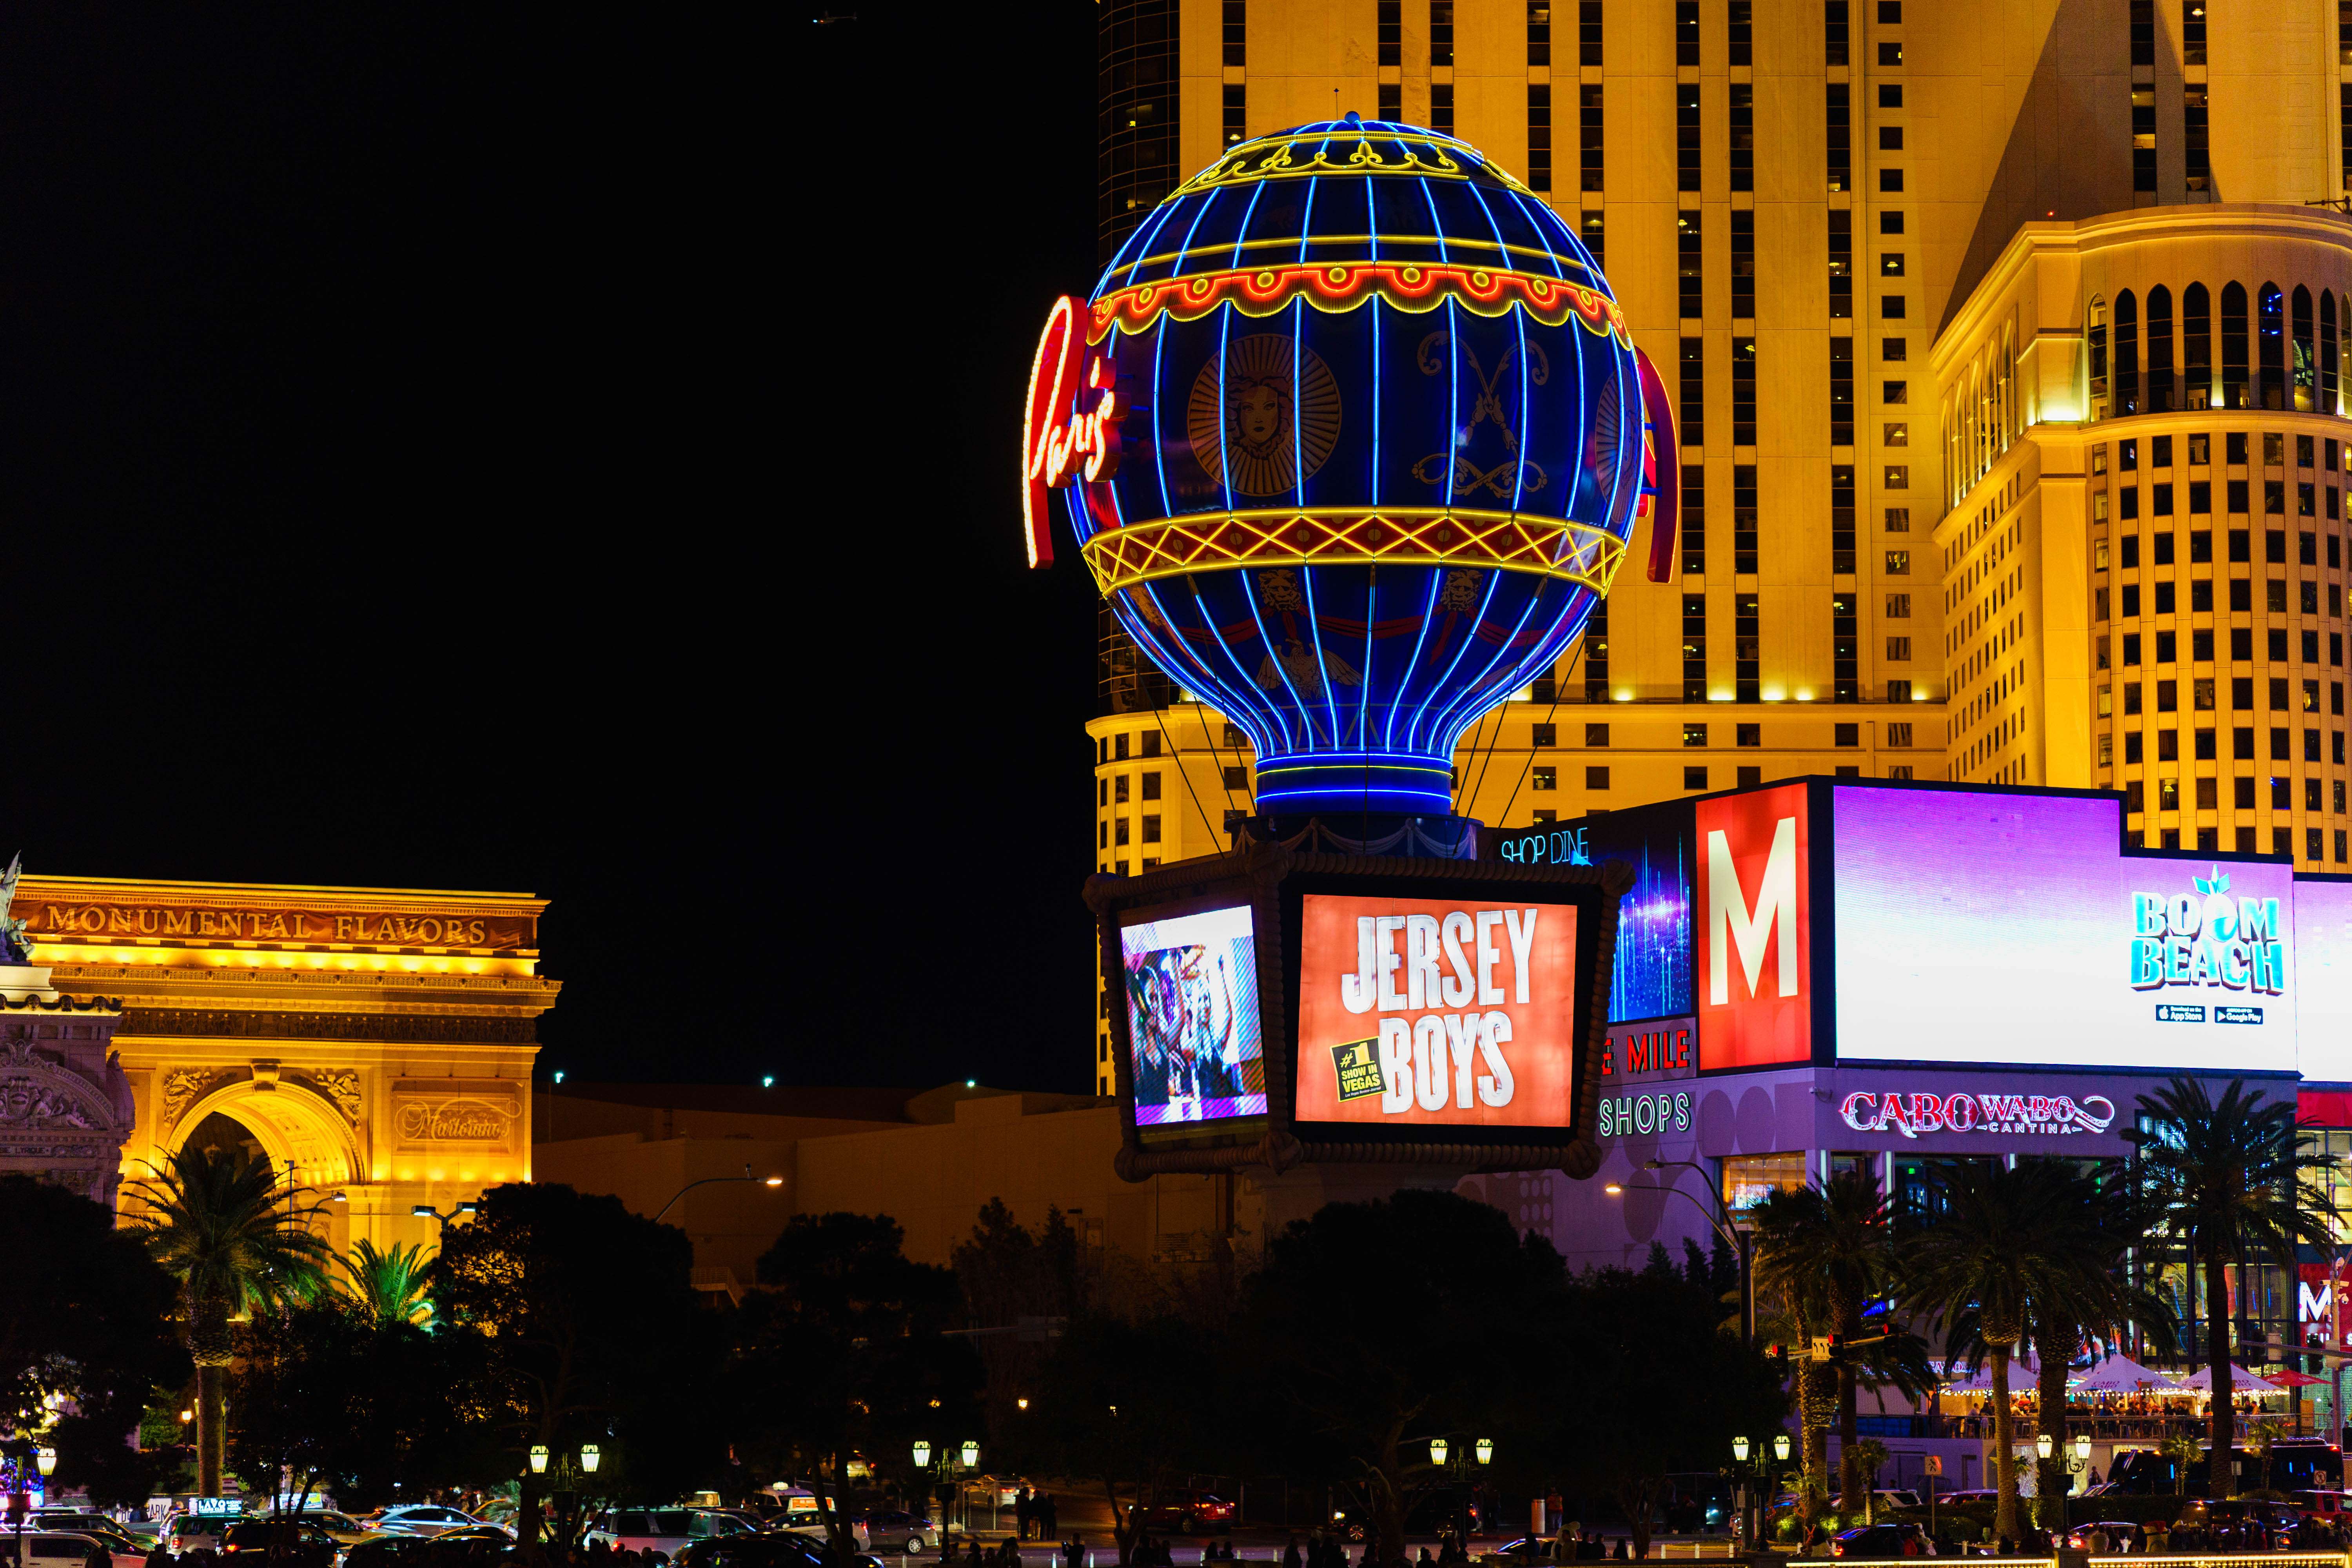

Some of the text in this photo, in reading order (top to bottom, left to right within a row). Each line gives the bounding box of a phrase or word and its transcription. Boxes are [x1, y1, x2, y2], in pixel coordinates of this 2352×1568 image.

[1023, 295, 1115, 569] Paris
[1501, 827, 1588, 864] SHOP DINE
[47, 906, 485, 944] MONUMENTAL FLAVORS
[1708, 816, 1798, 1006] M
[2131, 890, 2280, 942] BOOM
[1341, 908, 1537, 1014] JERSEY
[2131, 936, 2284, 996] BEACH
[2171, 1011, 2202, 1021] App Store
[2227, 1013, 2261, 1023] Google Play
[1340, 1042, 1375, 1068] #1
[1379, 1010, 1514, 1113] BOYS
[1627, 1030, 1689, 1073] MILE
[1341, 1064, 1378, 1080] SHOW IN
[1342, 1074, 1381, 1093] VEGAS
[1599, 1092, 1690, 1137] SHOPS
[1838, 1091, 2078, 1138] CABO WABO
[1989, 1122, 2071, 1134] CANTINA
[198, 1498, 226, 1508] LAVO
